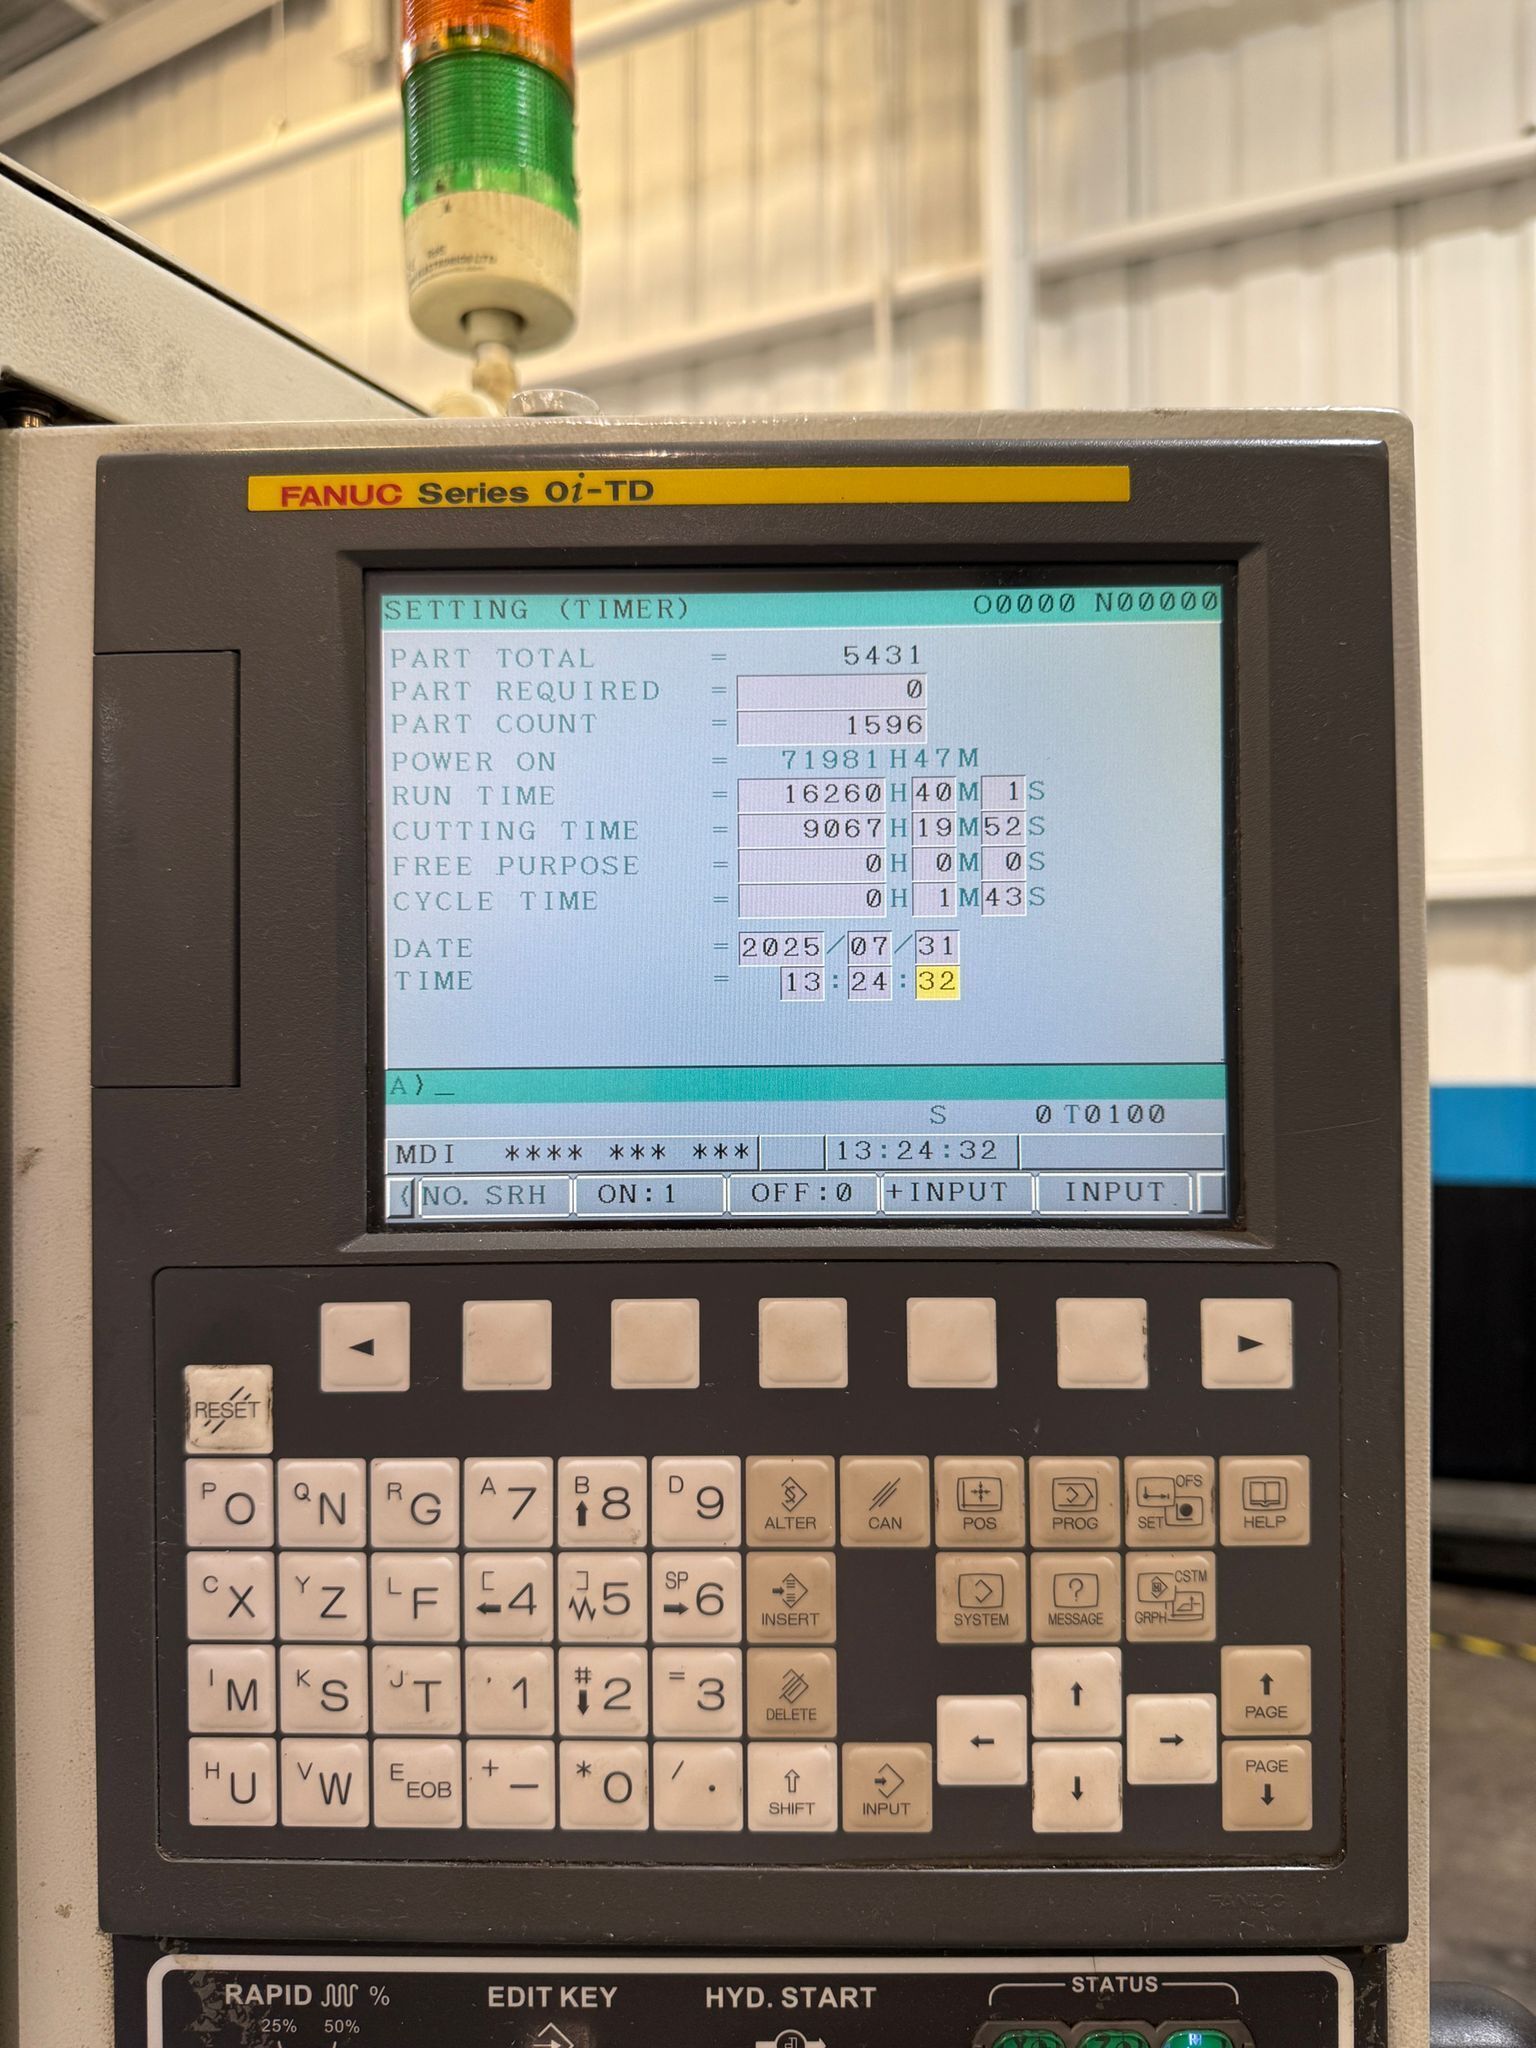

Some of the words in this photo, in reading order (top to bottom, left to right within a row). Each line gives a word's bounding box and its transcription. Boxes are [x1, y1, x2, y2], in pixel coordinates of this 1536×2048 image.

[281, 483, 403, 507] FANUC
[418, 482, 529, 504] Series
[384, 600, 528, 620] SETTING
[560, 598, 688, 620] (TIMER)
[1095, 592, 1218, 612] N00000
[391, 648, 470, 668] PART
[496, 648, 594, 668] TOTAL
[844, 646, 920, 665] 5431
[392, 681, 471, 701] PART
[496, 681, 660, 701] REQUIRED
[908, 679, 923, 699] 0
[392, 714, 471, 734] PART
[496, 714, 596, 733] COUNT
[848, 715, 923, 735] 1596
[392, 752, 493, 772] POWER
[517, 752, 555, 771] ON
[392, 786, 451, 806] RUN
[478, 786, 555, 806] TIME
[392, 821, 535, 841] CUTTING
[561, 821, 638, 840] TIME
[393, 857, 471, 876] FREE
[496, 856, 639, 876] PURPOSE
[393, 892, 493, 911] CYCLE
[520, 892, 598, 911] TIME
[394, 938, 472, 958] DATE
[395, 970, 472, 991] TIME
[930, 1105, 946, 1125] S
[396, 1145, 454, 1164] MDI
[839, 1140, 997, 1160] 13:24:32
[423, 1186, 468, 1205] NO.
[486, 1185, 545, 1205] SRH
[598, 1184, 674, 1203] ON:1
[751, 1182, 853, 1202] OFF:0
[887, 1182, 1007, 1202] +INPUT
[1066, 1182, 1165, 1201] INPUT
[195, 1401, 260, 1419] RESET
[1176, 1475, 1202, 1487] OFS
[202, 1483, 216, 1498] P
[225, 1493, 255, 1524] O
[295, 1483, 311, 1501] Q
[320, 1492, 345, 1524] N
[388, 1483, 402, 1499] R
[411, 1493, 441, 1525] G
[480, 1477, 496, 1494] A
[508, 1487, 537, 1519] 7
[575, 1476, 589, 1493] B
[602, 1486, 631, 1519] 8
[669, 1476, 683, 1493] D
[696, 1486, 724, 1519] 9
[765, 1517, 816, 1529] ALTER
[868, 1518, 902, 1529] CAN
[963, 1518, 996, 1530] POS
[1052, 1517, 1098, 1530] PROG
[1138, 1516, 1164, 1528] SET
[1243, 1516, 1286, 1529] HELP
[1175, 1570, 1207, 1582] CSTM
[203, 1576, 218, 1593] C
[229, 1586, 255, 1618] X
[296, 1576, 310, 1593] Y
[321, 1586, 347, 1618] Z
[388, 1577, 402, 1595] L
[414, 1587, 438, 1619] F
[508, 1583, 537, 1615] 4
[603, 1582, 630, 1615] 5
[665, 1572, 688, 1589] SP
[696, 1583, 724, 1615] 6
[762, 1613, 820, 1626] INSERT
[954, 1613, 1009, 1626] SYSTEM
[1049, 1612, 1103, 1625] MESSAGE
[1135, 1612, 1167, 1623] GRPH
[209, 1669, 213, 1686] I
[227, 1679, 257, 1711] M
[297, 1670, 311, 1687] K
[321, 1680, 349, 1711] S
[390, 1671, 403, 1688] J
[414, 1681, 441, 1712] T
[513, 1677, 527, 1708] 1
[604, 1678, 631, 1709] 2
[697, 1678, 725, 1710] 3
[767, 1708, 817, 1721] DELETE
[1245, 1706, 1288, 1718] PAGE
[1246, 1760, 1288, 1772] PAGE
[206, 1763, 220, 1779] H
[231, 1772, 256, 1804] U
[298, 1763, 313, 1780] V
[320, 1772, 352, 1805] W
[391, 1764, 404, 1781] E
[408, 1782, 452, 1798] EOB
[769, 1803, 816, 1815] SHIFT
[863, 1803, 910, 1815] INPUT
[1072, 1976, 1158, 1993] STATUS
[225, 1984, 312, 2005] RAPID
[370, 1986, 390, 2007] %
[488, 1986, 555, 2007] EDIT
[560, 1987, 618, 2007] KEY
[706, 1987, 772, 2008] HYD.
[782, 1987, 876, 2008] START
[262, 2019, 297, 2033] 25%
[324, 2019, 360, 2034] 50%
